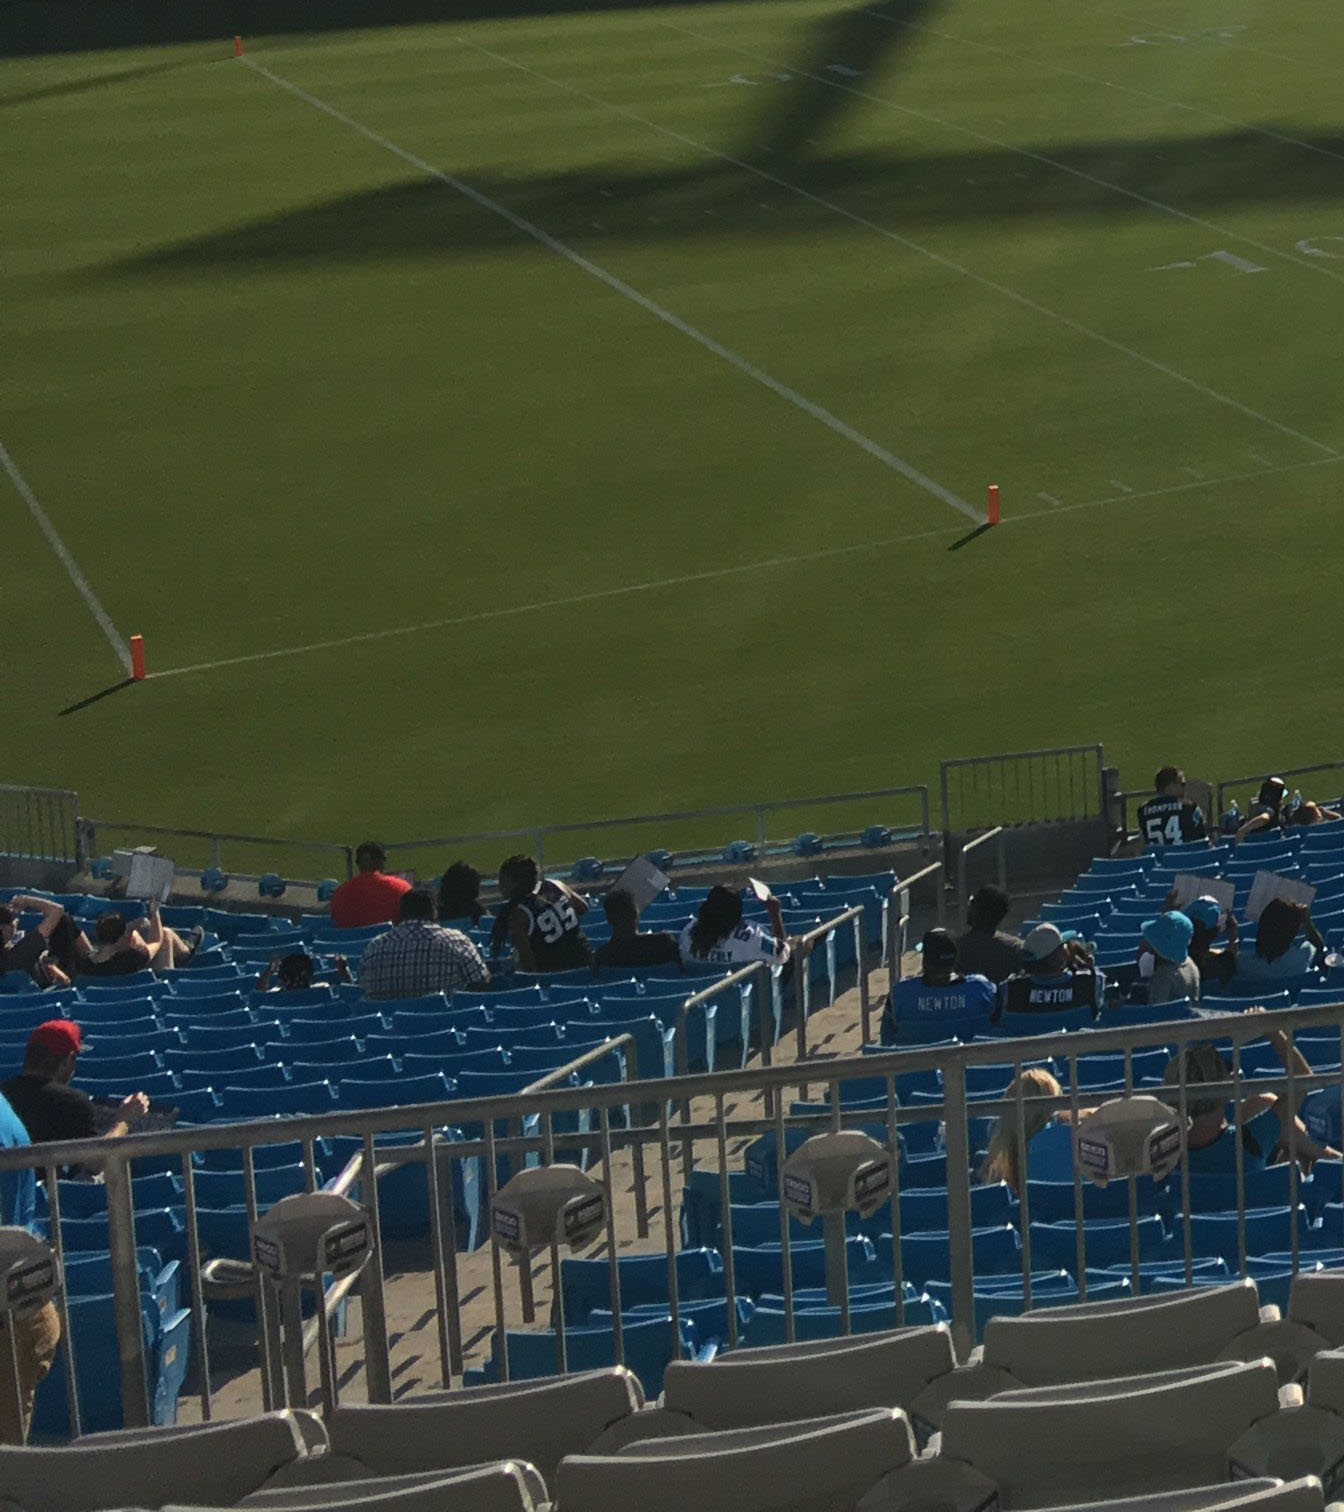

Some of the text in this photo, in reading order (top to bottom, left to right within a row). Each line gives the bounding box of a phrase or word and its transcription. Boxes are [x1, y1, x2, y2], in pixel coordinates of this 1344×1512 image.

[1145, 815, 1184, 846] 54
[536, 895, 580, 944] 95
[917, 994, 967, 1012] NEWTON
[1029, 987, 1074, 1004] NEWTON
